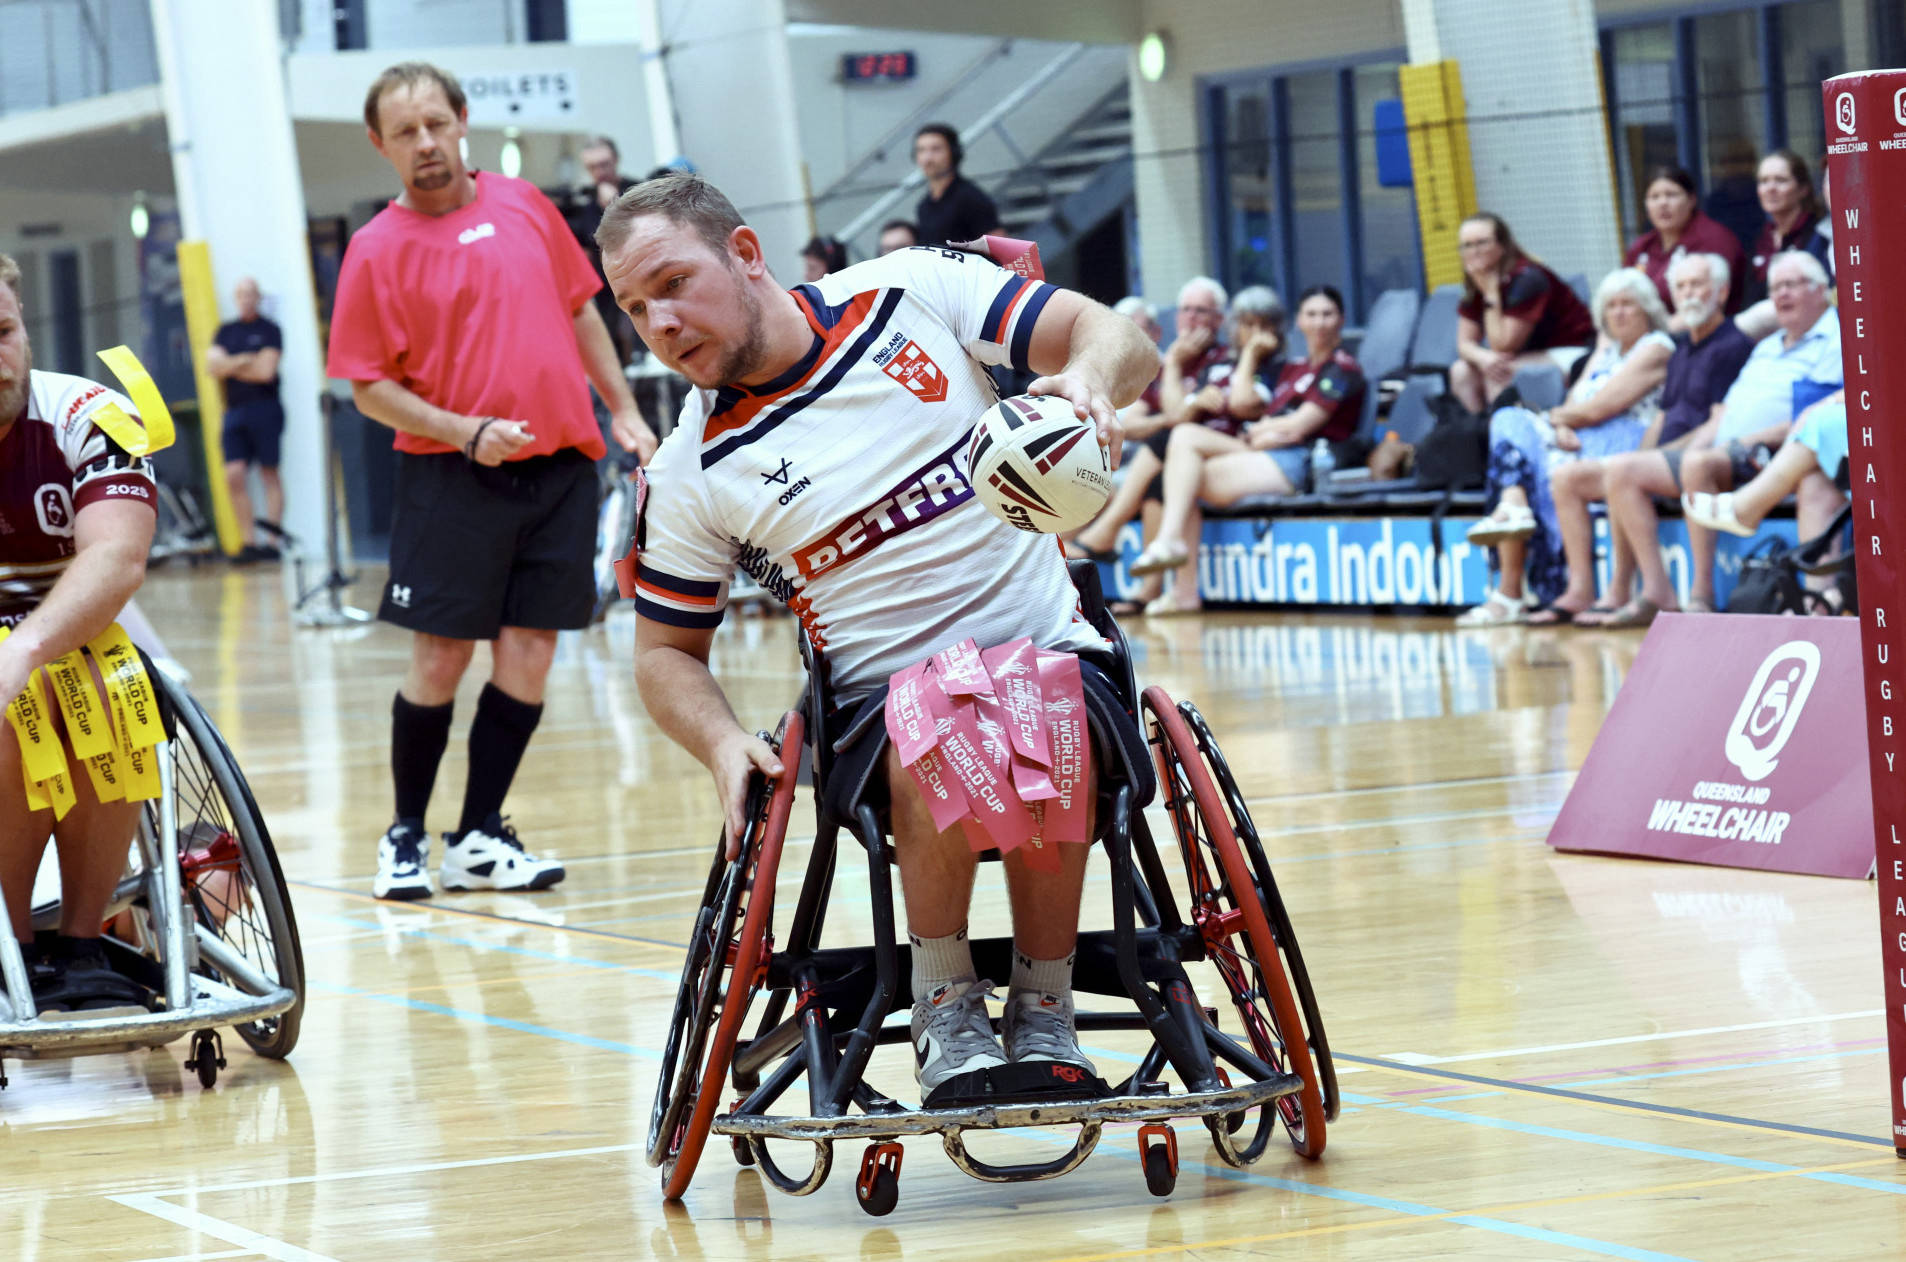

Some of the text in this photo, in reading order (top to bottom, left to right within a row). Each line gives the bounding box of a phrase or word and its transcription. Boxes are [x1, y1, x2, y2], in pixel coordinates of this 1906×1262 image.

[460, 74, 569, 99] OILETS
[1827, 142, 1868, 155] WHEELCHAIR
[1879, 139, 1906, 150] WHEE
[872, 332, 903, 364] ENGLAND
[106, 484, 149, 498] 2025
[778, 476, 812, 506] OXEN
[61, 668, 83, 709] WORLD
[76, 711, 92, 735] CUP
[134, 700, 148, 725] CUP
[906, 720, 920, 741] CUP
[1020, 724, 1034, 749] CUP
[131, 751, 144, 775] CUP
[957, 731, 977, 756] RUGBY
[975, 756, 998, 785] LEAGUE
[1073, 720, 1082, 783] RUGBY LEAGUE
[100, 762, 116, 784] CUP
[945, 735, 1006, 813] WORLD CUP
[1060, 720, 1074, 809] WORLD CUP
[928, 771, 948, 799] CUP
[1692, 780, 1771, 805] QUEENSLAND
[1647, 798, 1791, 844] WHEELCHAIR
